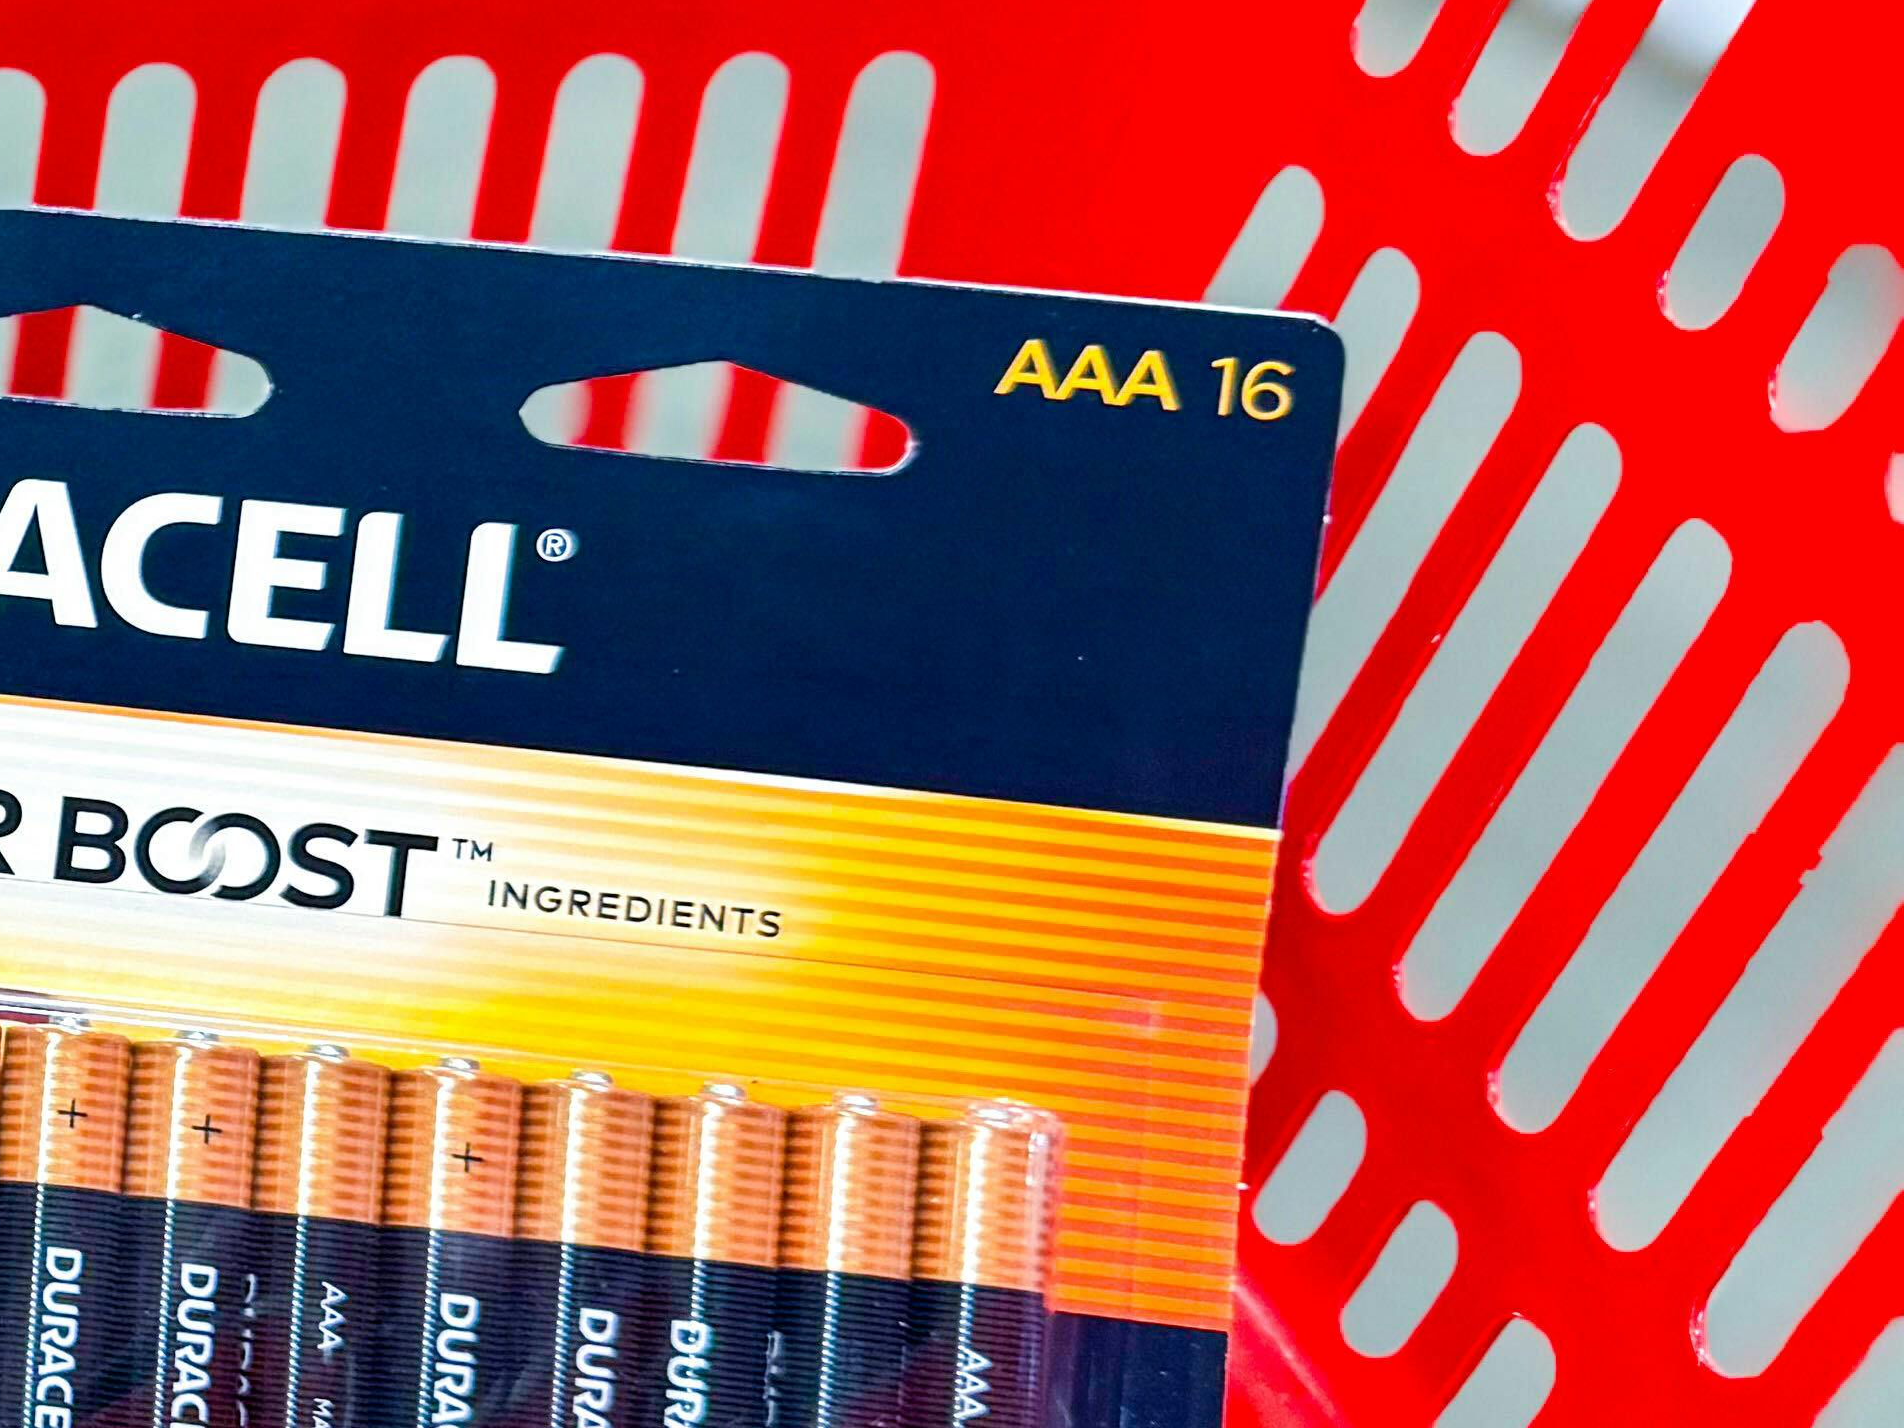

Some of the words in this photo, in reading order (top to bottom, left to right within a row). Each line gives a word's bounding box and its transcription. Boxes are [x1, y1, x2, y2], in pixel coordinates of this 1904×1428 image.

[993, 339, 1182, 411] AAA
[1211, 357, 1295, 420] 16
[487, 879, 782, 937] INGREDIENTS
[317, 1280, 349, 1353] AAA
[954, 1348, 993, 1422] AAA
